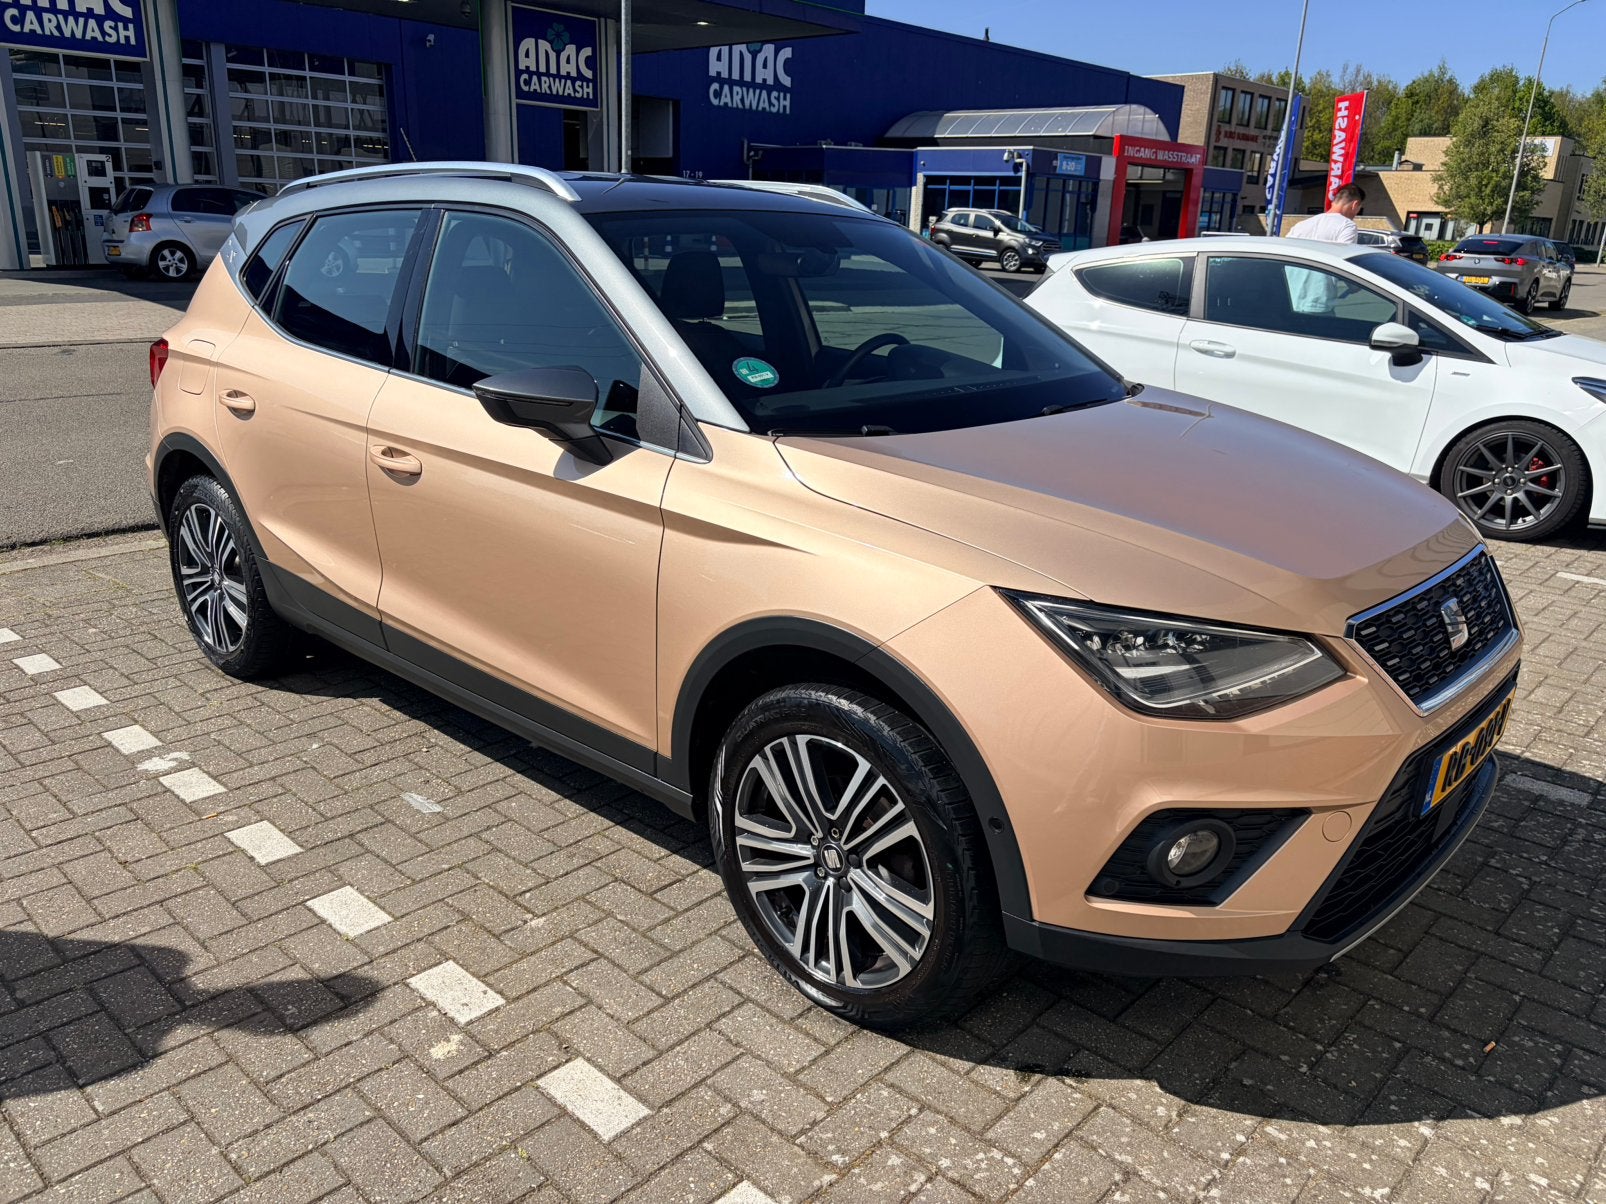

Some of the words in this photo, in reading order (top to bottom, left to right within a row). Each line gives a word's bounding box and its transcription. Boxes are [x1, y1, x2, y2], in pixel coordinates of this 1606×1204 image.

[3, 8, 136, 45] CARWASH
[518, 37, 593, 79] ANAC
[708, 43, 792, 88] ANAC
[520, 73, 593, 99] CARWASH
[709, 82, 791, 114] CARWASH
[1124, 145, 1156, 160] INGANG
[1157, 149, 1201, 164] WASSTRAAT
